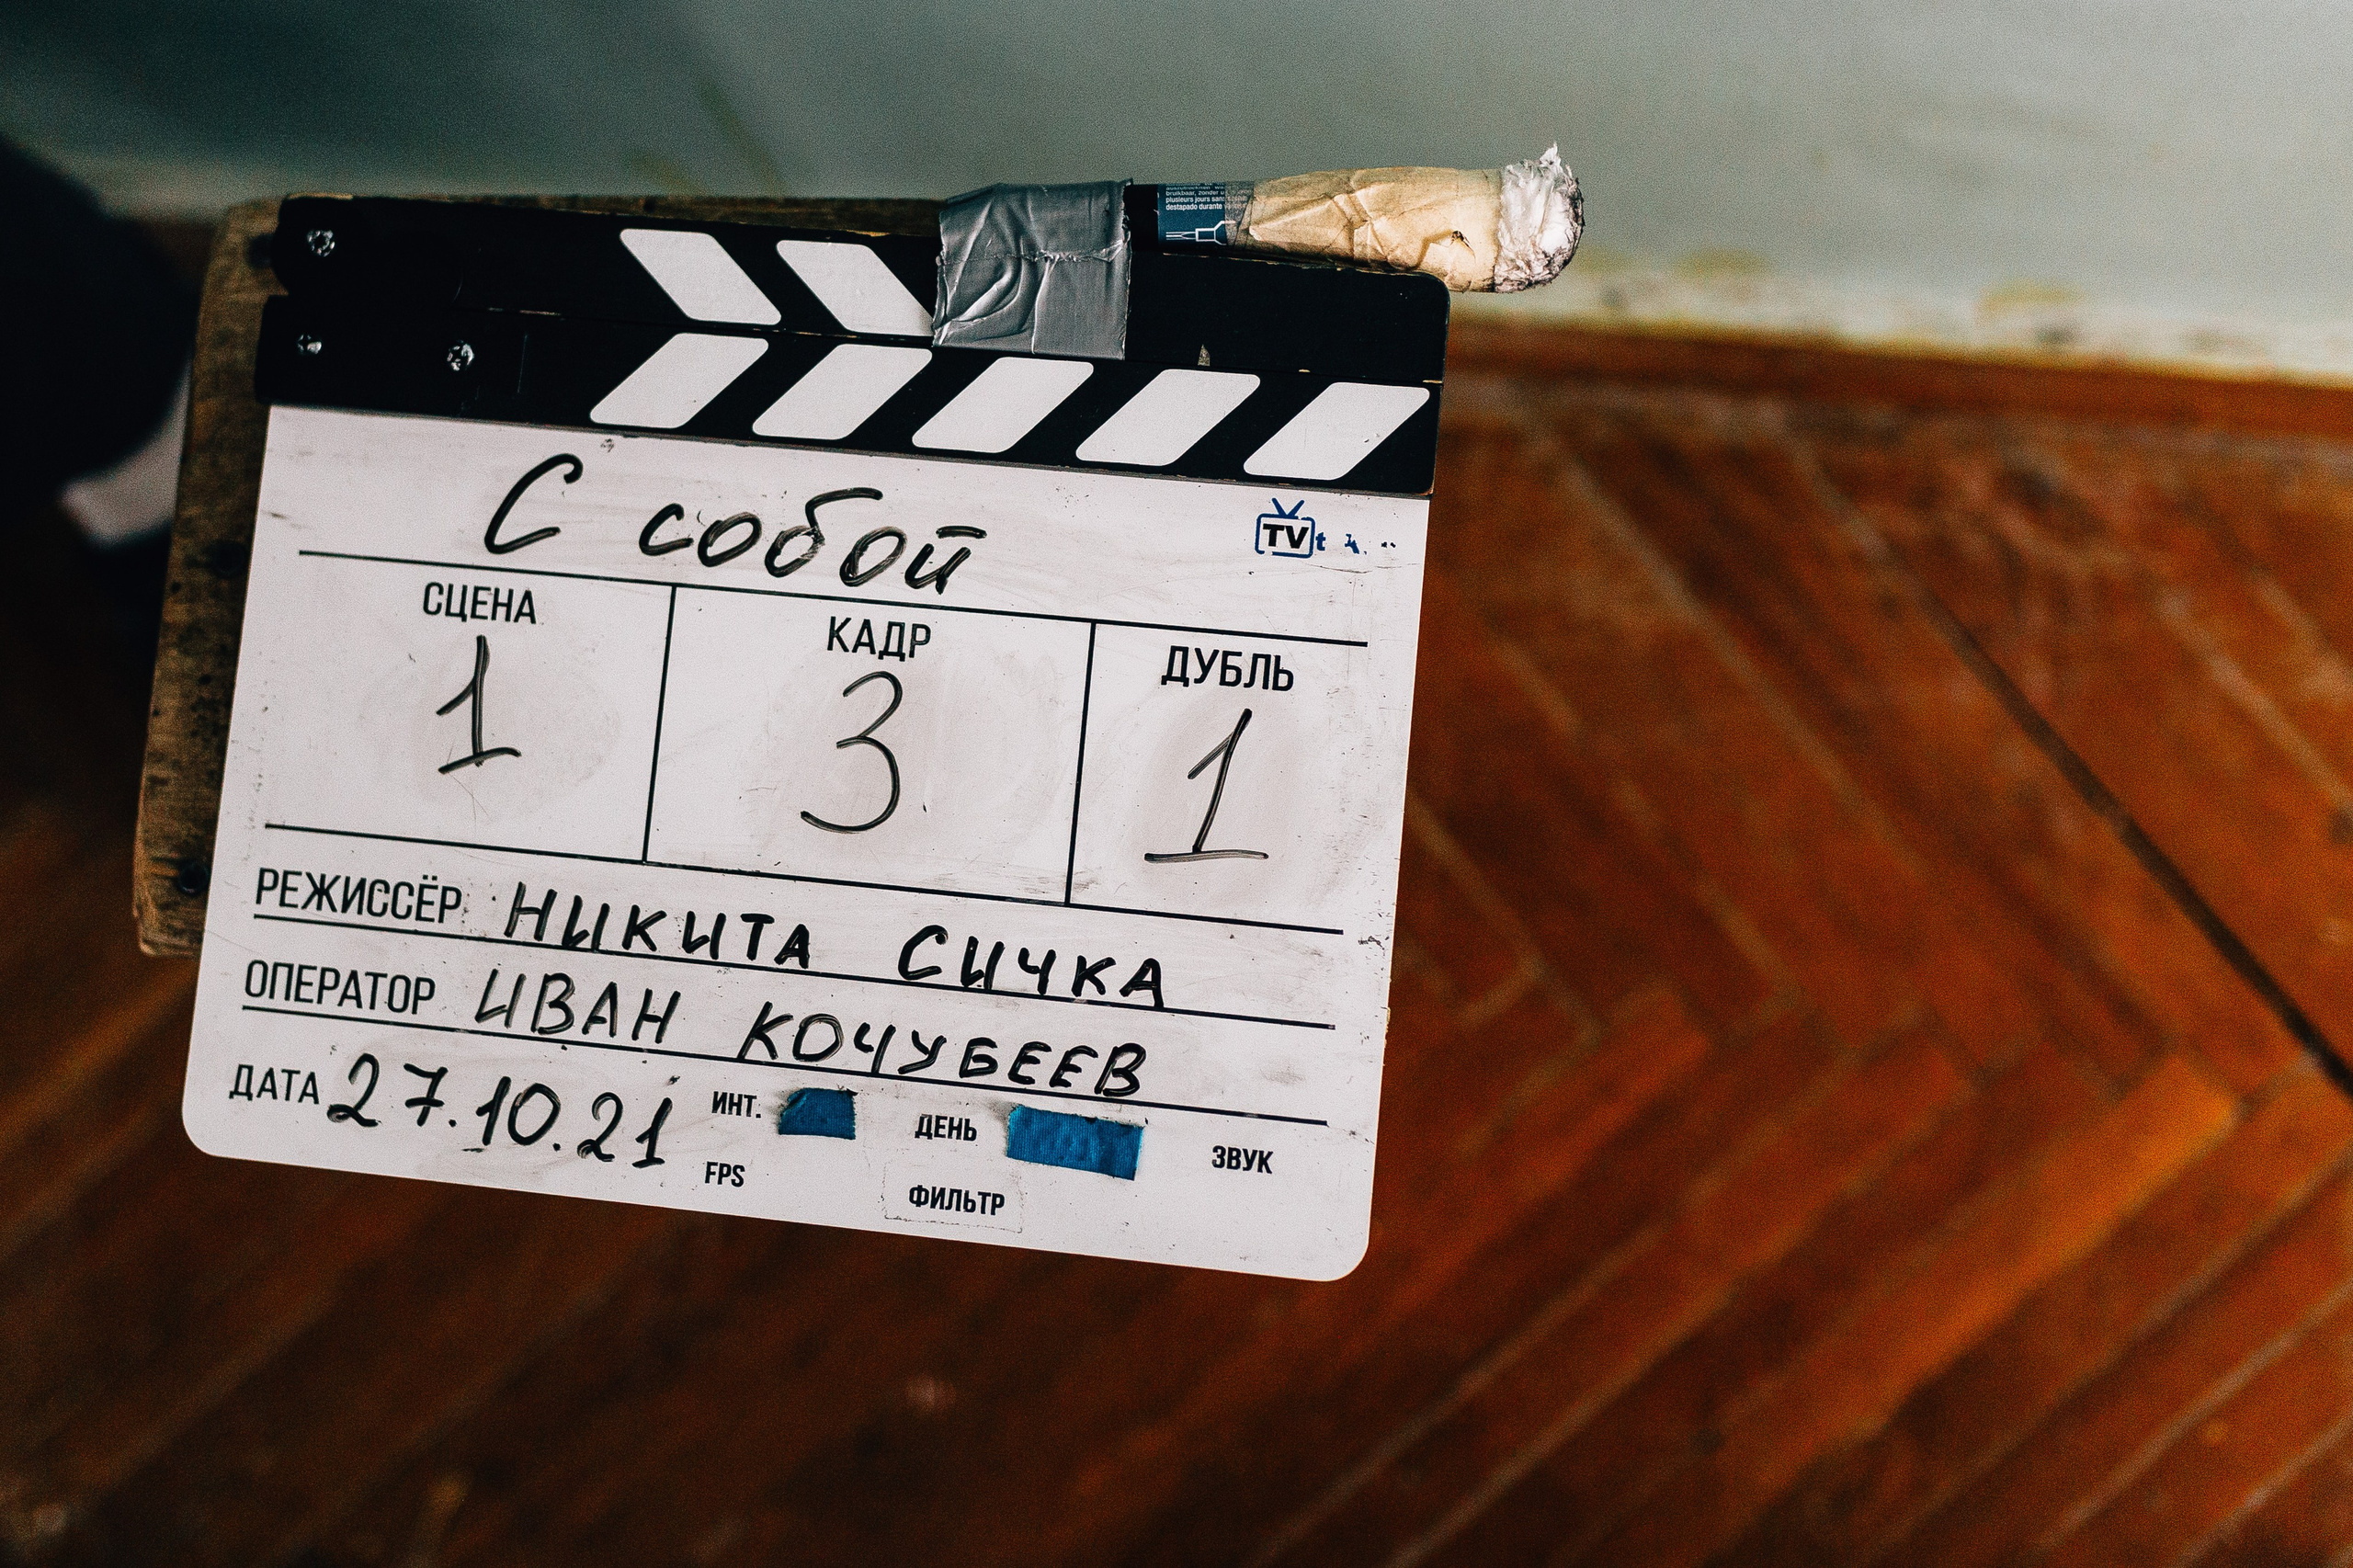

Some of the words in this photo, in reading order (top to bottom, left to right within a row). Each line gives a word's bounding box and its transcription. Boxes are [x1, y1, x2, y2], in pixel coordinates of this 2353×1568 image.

[638, 487, 987, 595] собой
[1262, 523, 1310, 550] TV
[422, 581, 537, 625] СЦЕНА
[826, 616, 931, 663] КАДР
[1160, 644, 1294, 692] ДУБЛЬ
[435, 634, 522, 775] 1
[800, 670, 904, 835] 3
[1143, 708, 1269, 864] 1
[254, 867, 462, 924] РЕЖИССЁР
[504, 880, 810, 970] НИКИТА
[898, 924, 1165, 1008] СИЧКА
[242, 959, 436, 1015] ОПЕРАТОР
[474, 968, 682, 1044] ИВАН
[736, 1000, 1147, 1096] КОЧУБЕЕВ
[228, 1063, 320, 1105] ДАТА
[710, 1090, 762, 1119] ИНТ.
[326, 1052, 674, 1168] 27.10.21
[914, 1113, 978, 1142] ДЕНЬ
[704, 1161, 745, 1187] FPS
[1211, 1145, 1274, 1175] ЗВУК
[908, 1184, 1006, 1217] ФИЛЬТР
